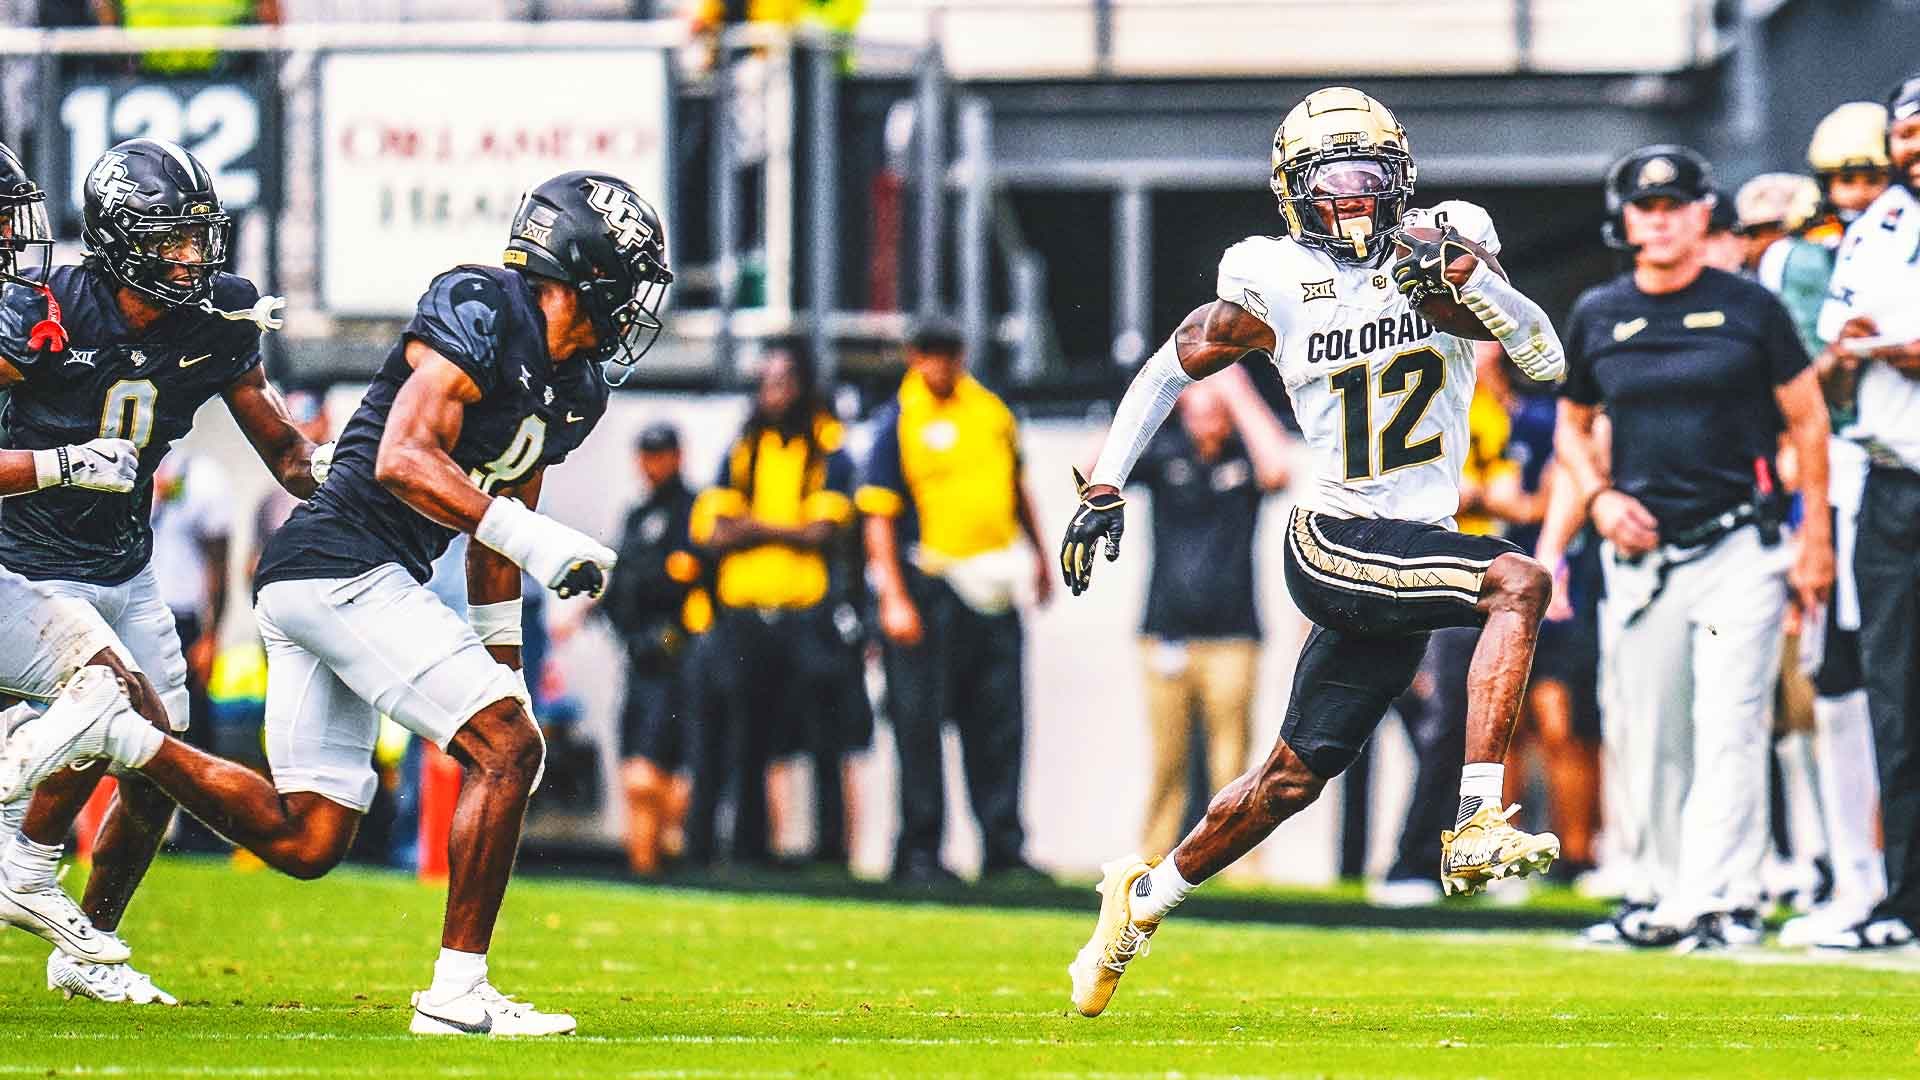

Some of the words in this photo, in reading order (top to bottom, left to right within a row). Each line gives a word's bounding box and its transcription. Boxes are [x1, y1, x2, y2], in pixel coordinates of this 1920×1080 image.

[92, 151, 140, 216] UCF
[586, 178, 654, 253] UCF
[1301, 278, 1336, 302] XII
[1308, 311, 1434, 363] COLORAD
[99, 379, 158, 457] 0
[1328, 345, 1447, 483] 12
